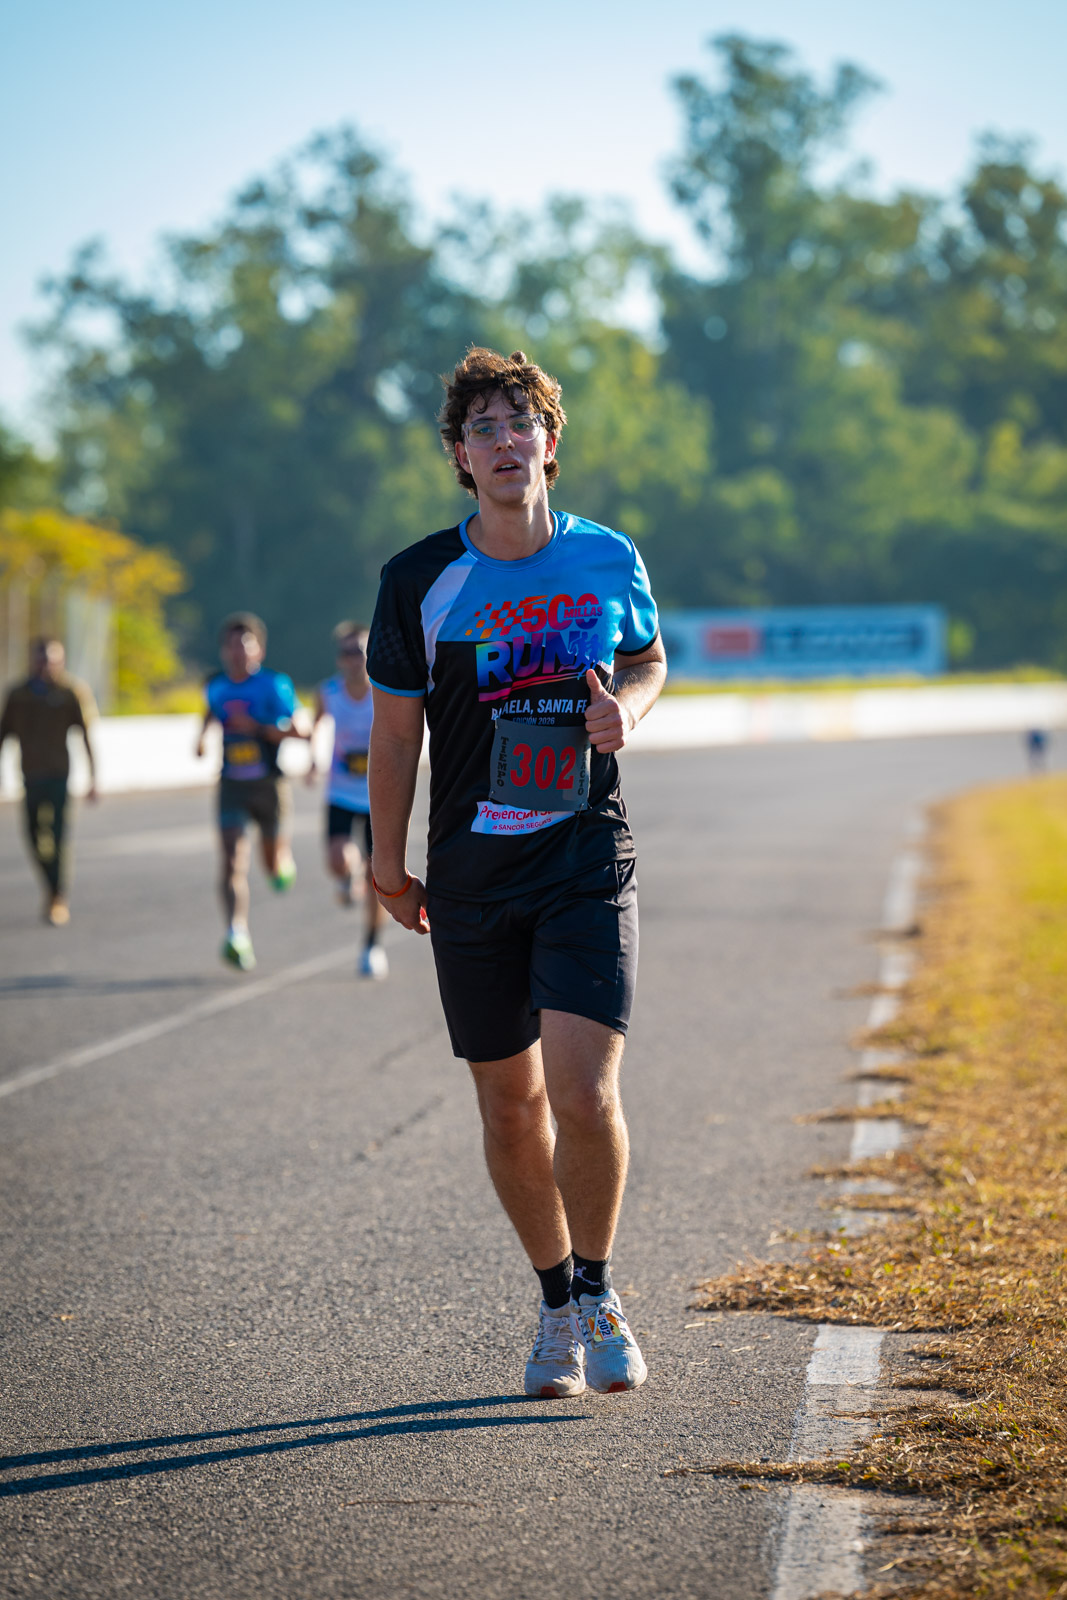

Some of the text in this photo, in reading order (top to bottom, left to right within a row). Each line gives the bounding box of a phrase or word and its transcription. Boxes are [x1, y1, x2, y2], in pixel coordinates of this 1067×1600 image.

[521, 593, 600, 633] 500
[564, 606, 603, 619] MILLAS
[475, 631, 581, 688] RUN
[491, 699, 533, 720] RAELA,
[537, 699, 573, 714] SANTA
[538, 717, 556, 725] 2026
[496, 736, 509, 787] TIEMPO
[510, 743, 577, 790] 302
[498, 823, 525, 831] SANCOR
[597, 1318, 611, 1336] 302
